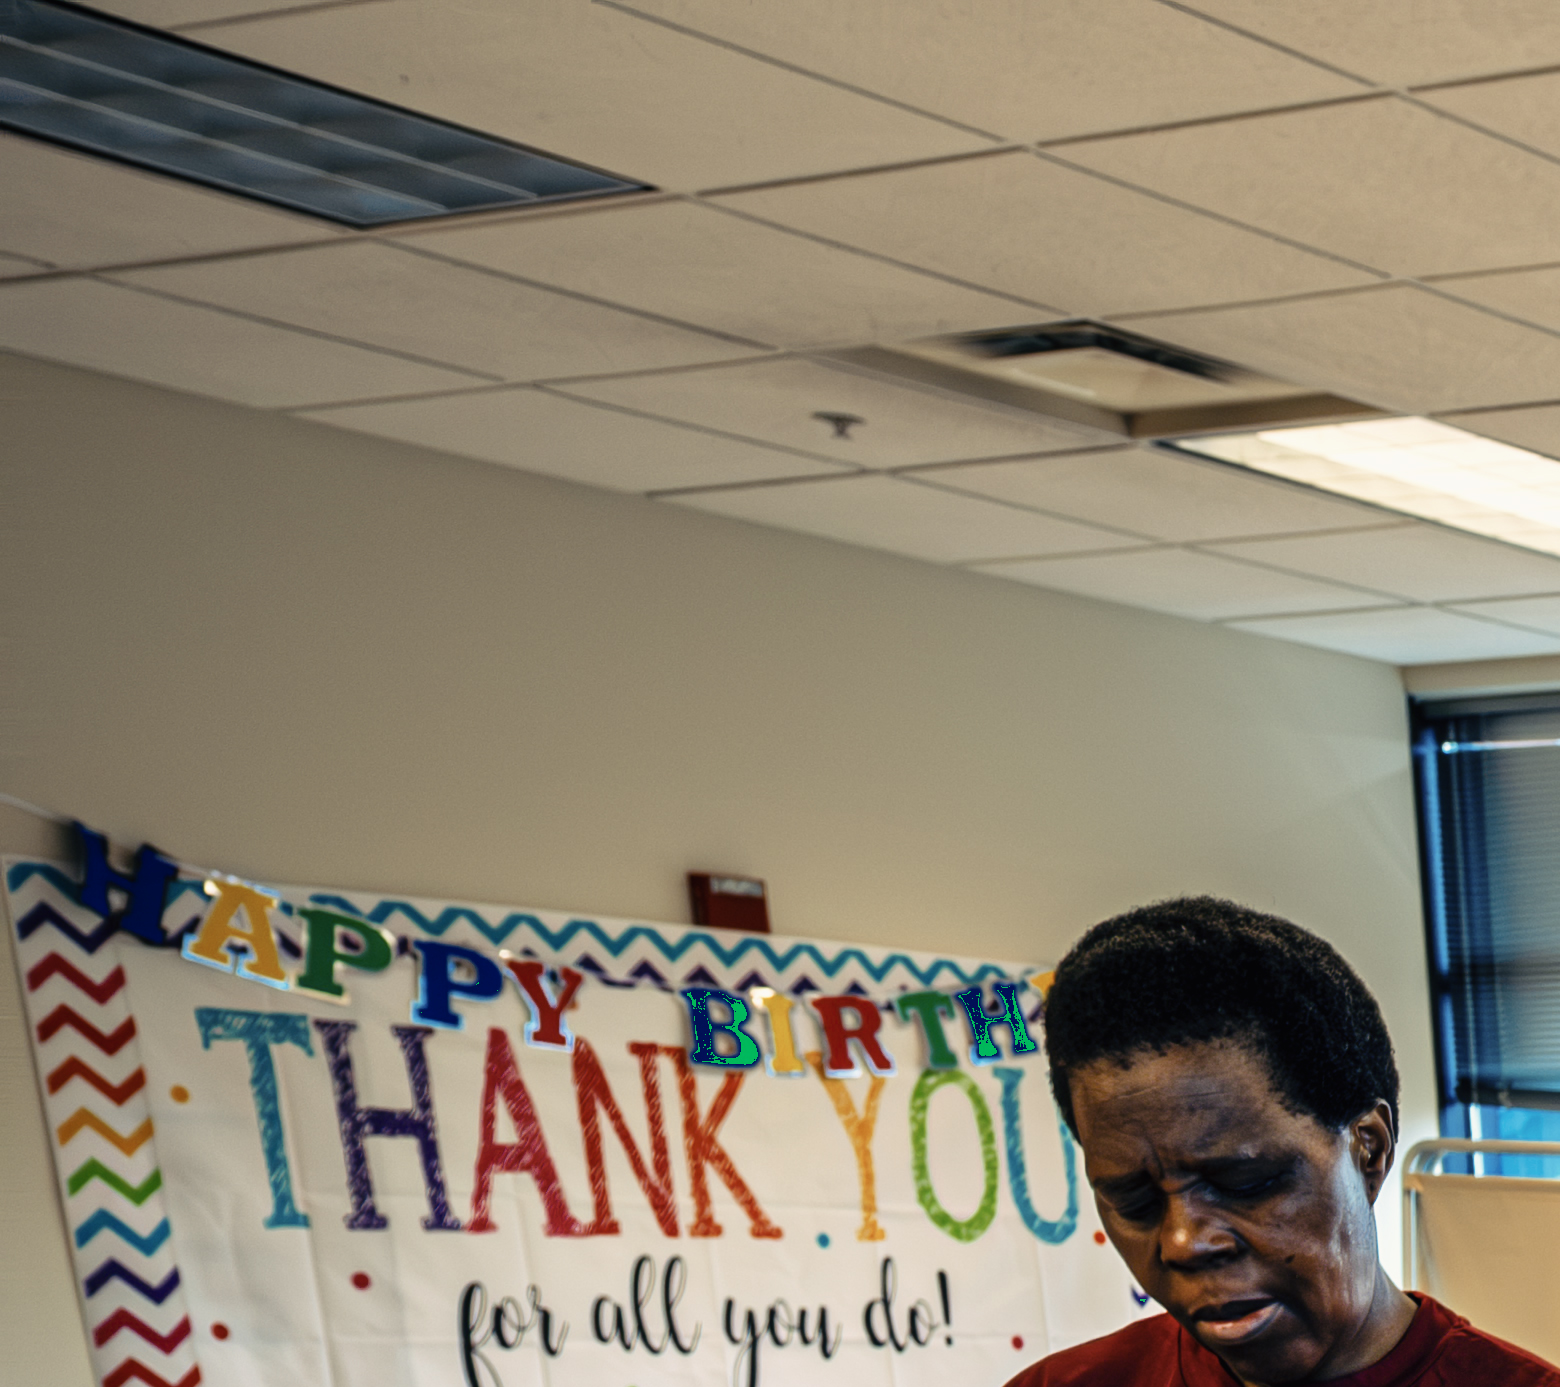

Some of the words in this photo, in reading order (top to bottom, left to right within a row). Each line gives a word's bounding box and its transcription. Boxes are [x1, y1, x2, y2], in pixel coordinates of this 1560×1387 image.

[73, 822, 584, 1052] HAPPY
[687, 972, 1058, 1078] BIRTH
[194, 1006, 784, 1241] THANK
[592, 1254, 702, 1356] all
[864, 1271, 955, 1353] do!
